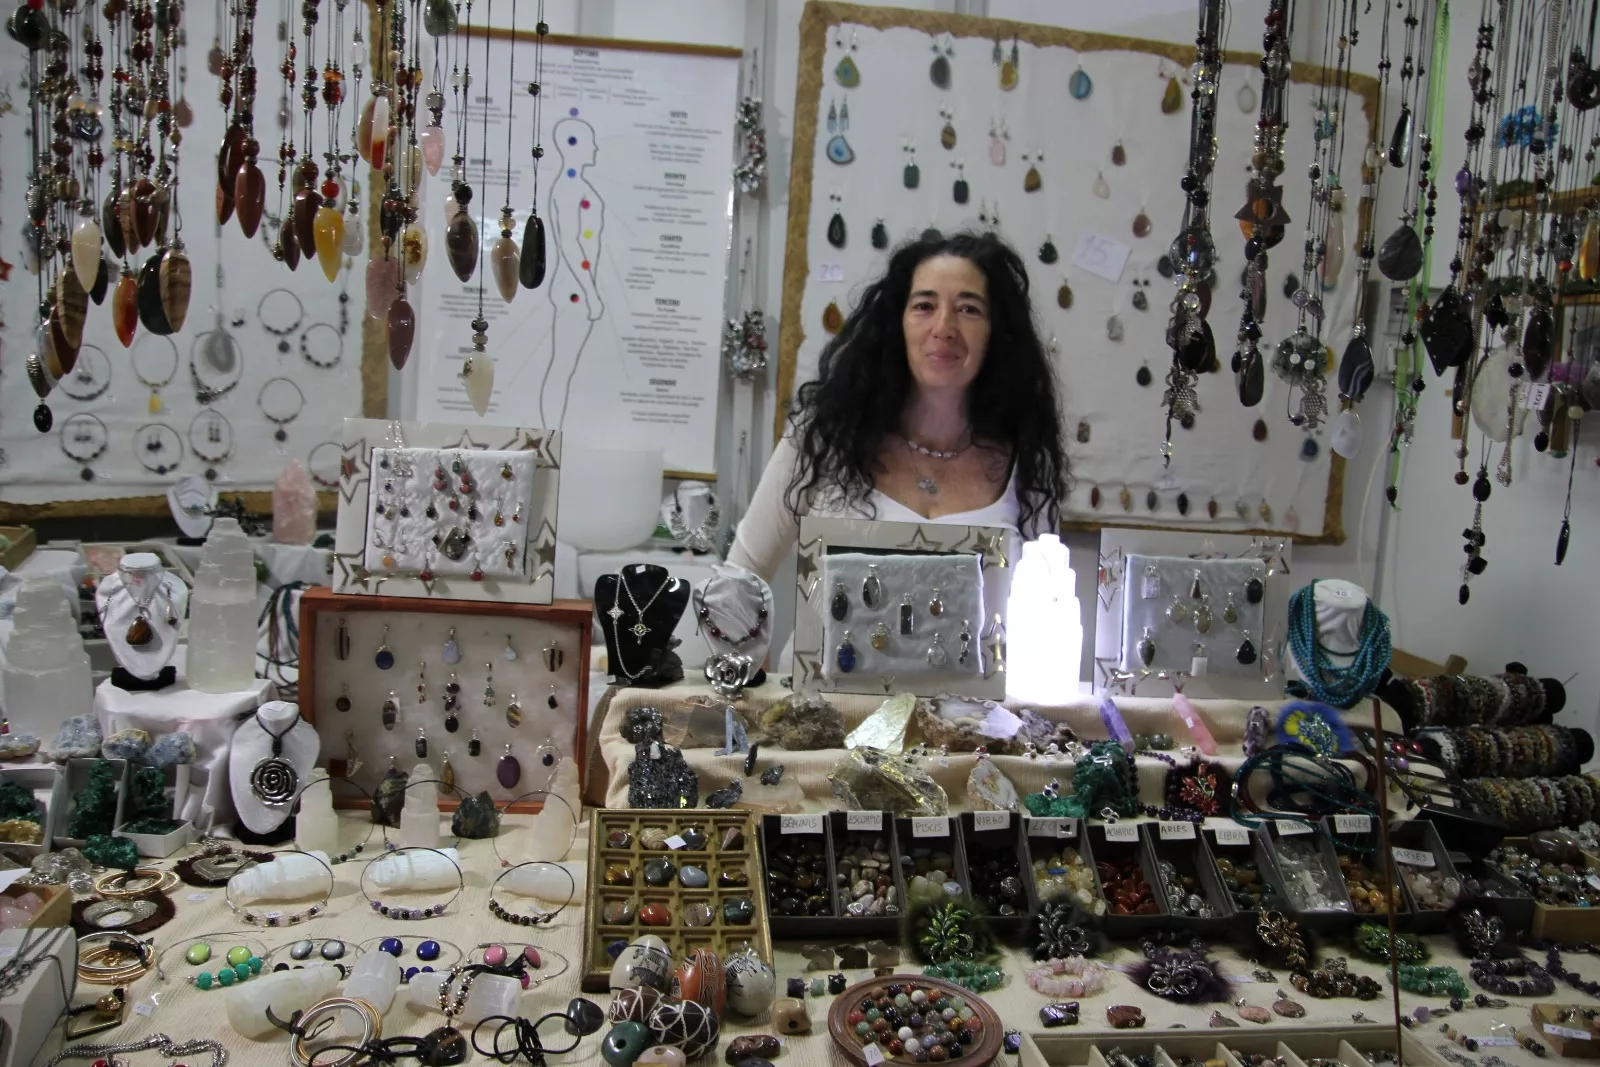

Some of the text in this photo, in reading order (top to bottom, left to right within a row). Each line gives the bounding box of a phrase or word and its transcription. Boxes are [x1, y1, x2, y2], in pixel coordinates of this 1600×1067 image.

[1080, 235, 1117, 265] 15
[1160, 824, 1188, 835] ARIES
[1218, 830, 1245, 841] LIBRA
[1395, 850, 1428, 862] ARIES
